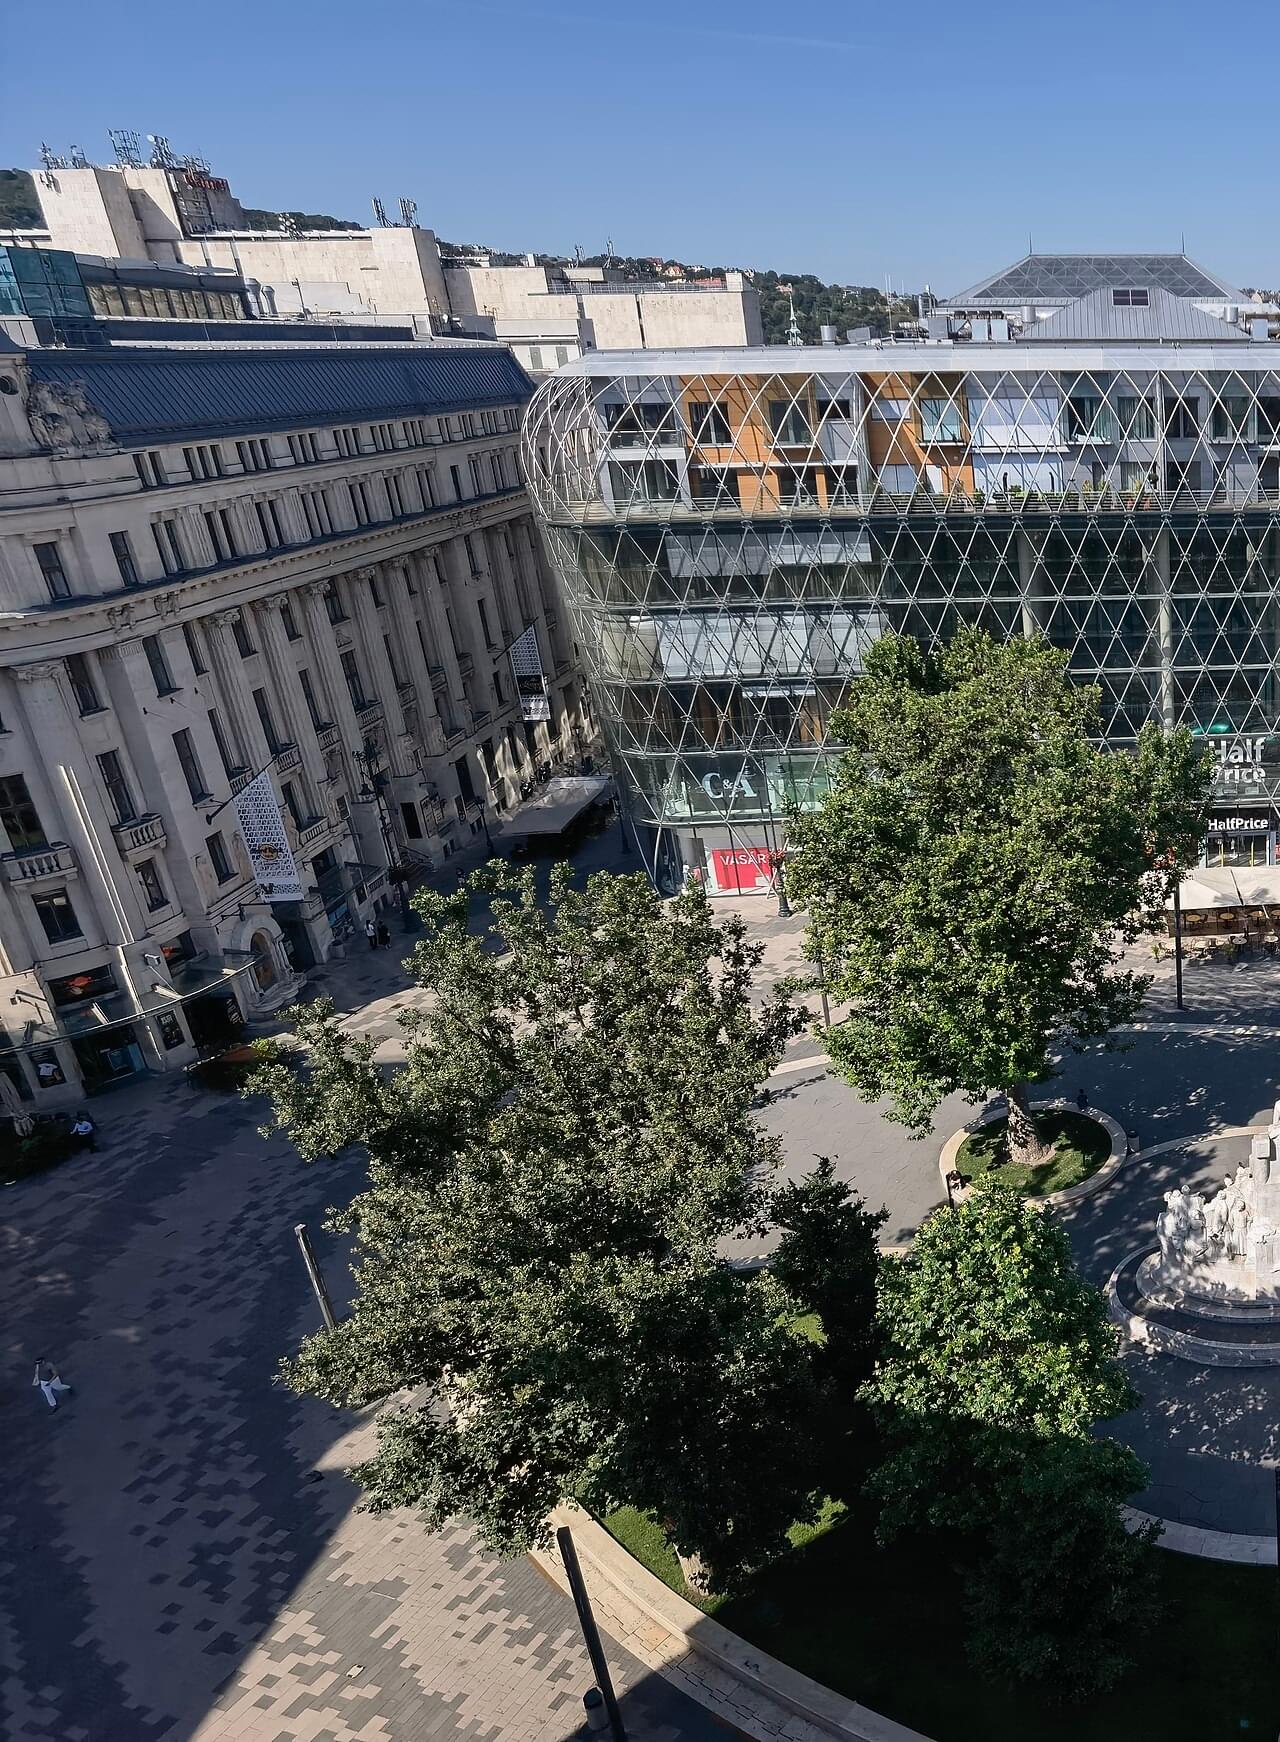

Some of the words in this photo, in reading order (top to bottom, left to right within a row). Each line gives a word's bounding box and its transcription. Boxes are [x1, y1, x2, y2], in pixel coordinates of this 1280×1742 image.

[1209, 737, 1265, 763] Half
[702, 771, 757, 798] C&A
[1208, 817, 1269, 831] HalfPrice
